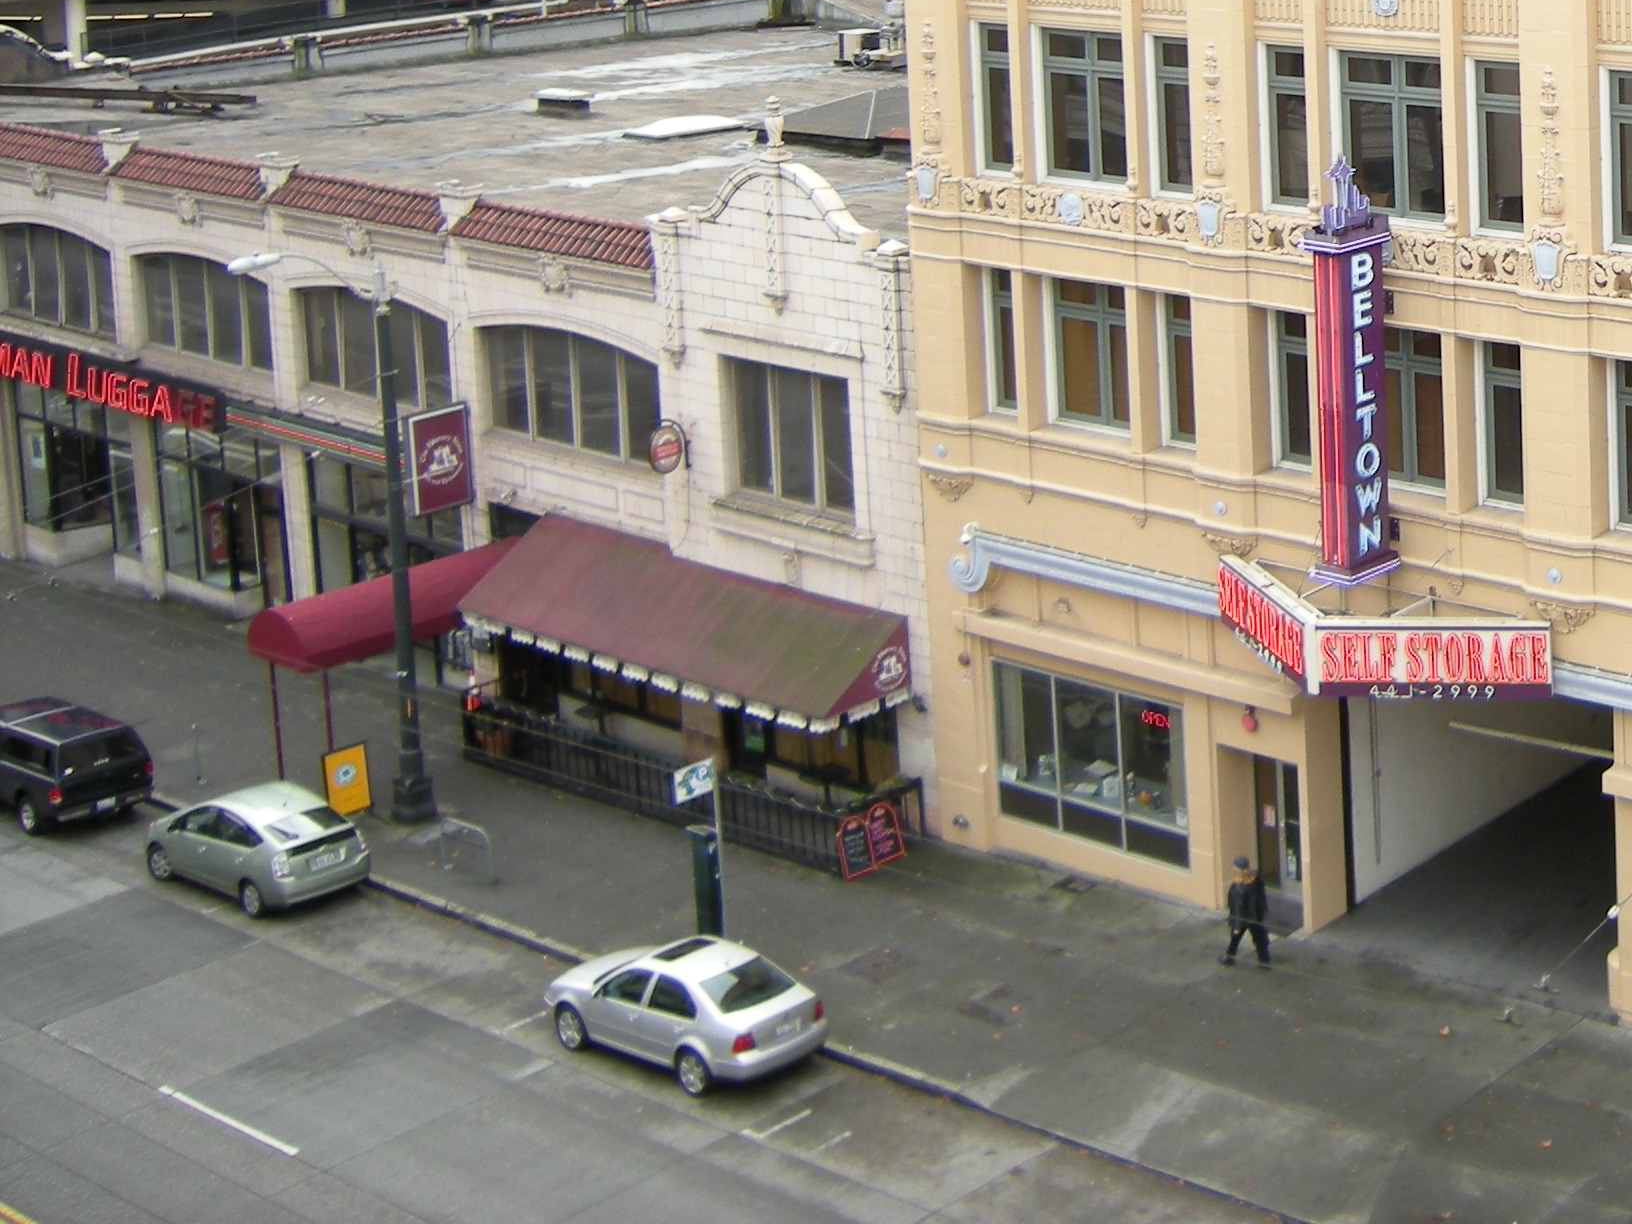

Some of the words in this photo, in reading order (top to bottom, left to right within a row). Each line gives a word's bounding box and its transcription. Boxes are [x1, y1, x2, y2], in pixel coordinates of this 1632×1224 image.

[66, 352, 217, 430] LUGGAGE
[1351, 251, 1383, 557] BELLTOWN
[1217, 564, 1245, 629] SELF
[1246, 584, 1303, 676] STORAGE
[1319, 631, 1397, 682] SELF
[1403, 632, 1549, 685] STORAGE
[1141, 708, 1171, 729] OPEN
